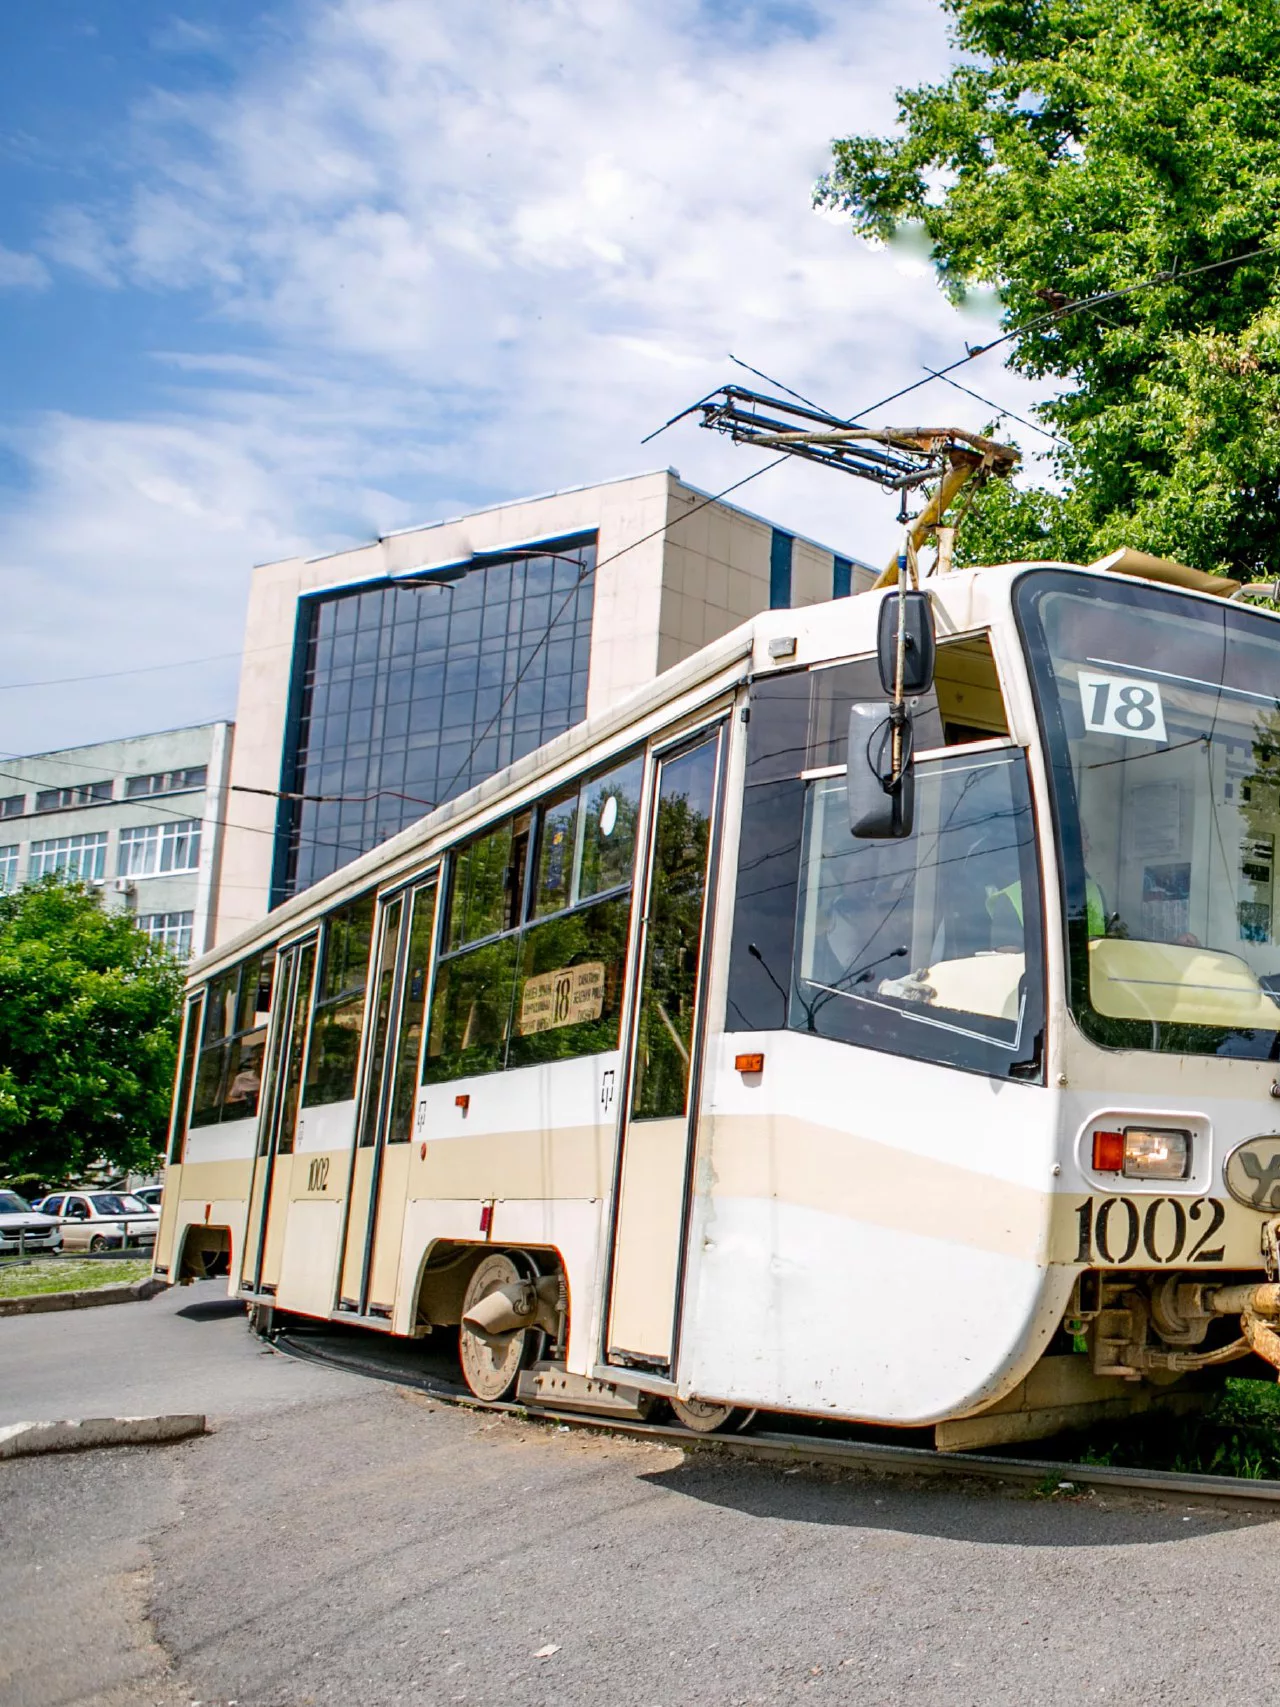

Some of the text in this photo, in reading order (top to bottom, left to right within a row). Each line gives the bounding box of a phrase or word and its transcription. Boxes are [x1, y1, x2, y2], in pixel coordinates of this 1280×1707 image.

[1088, 683, 1156, 731] 18
[553, 977, 570, 1024] 18
[307, 1157, 330, 1191] 1002
[1073, 1196, 1226, 1264] 1002
